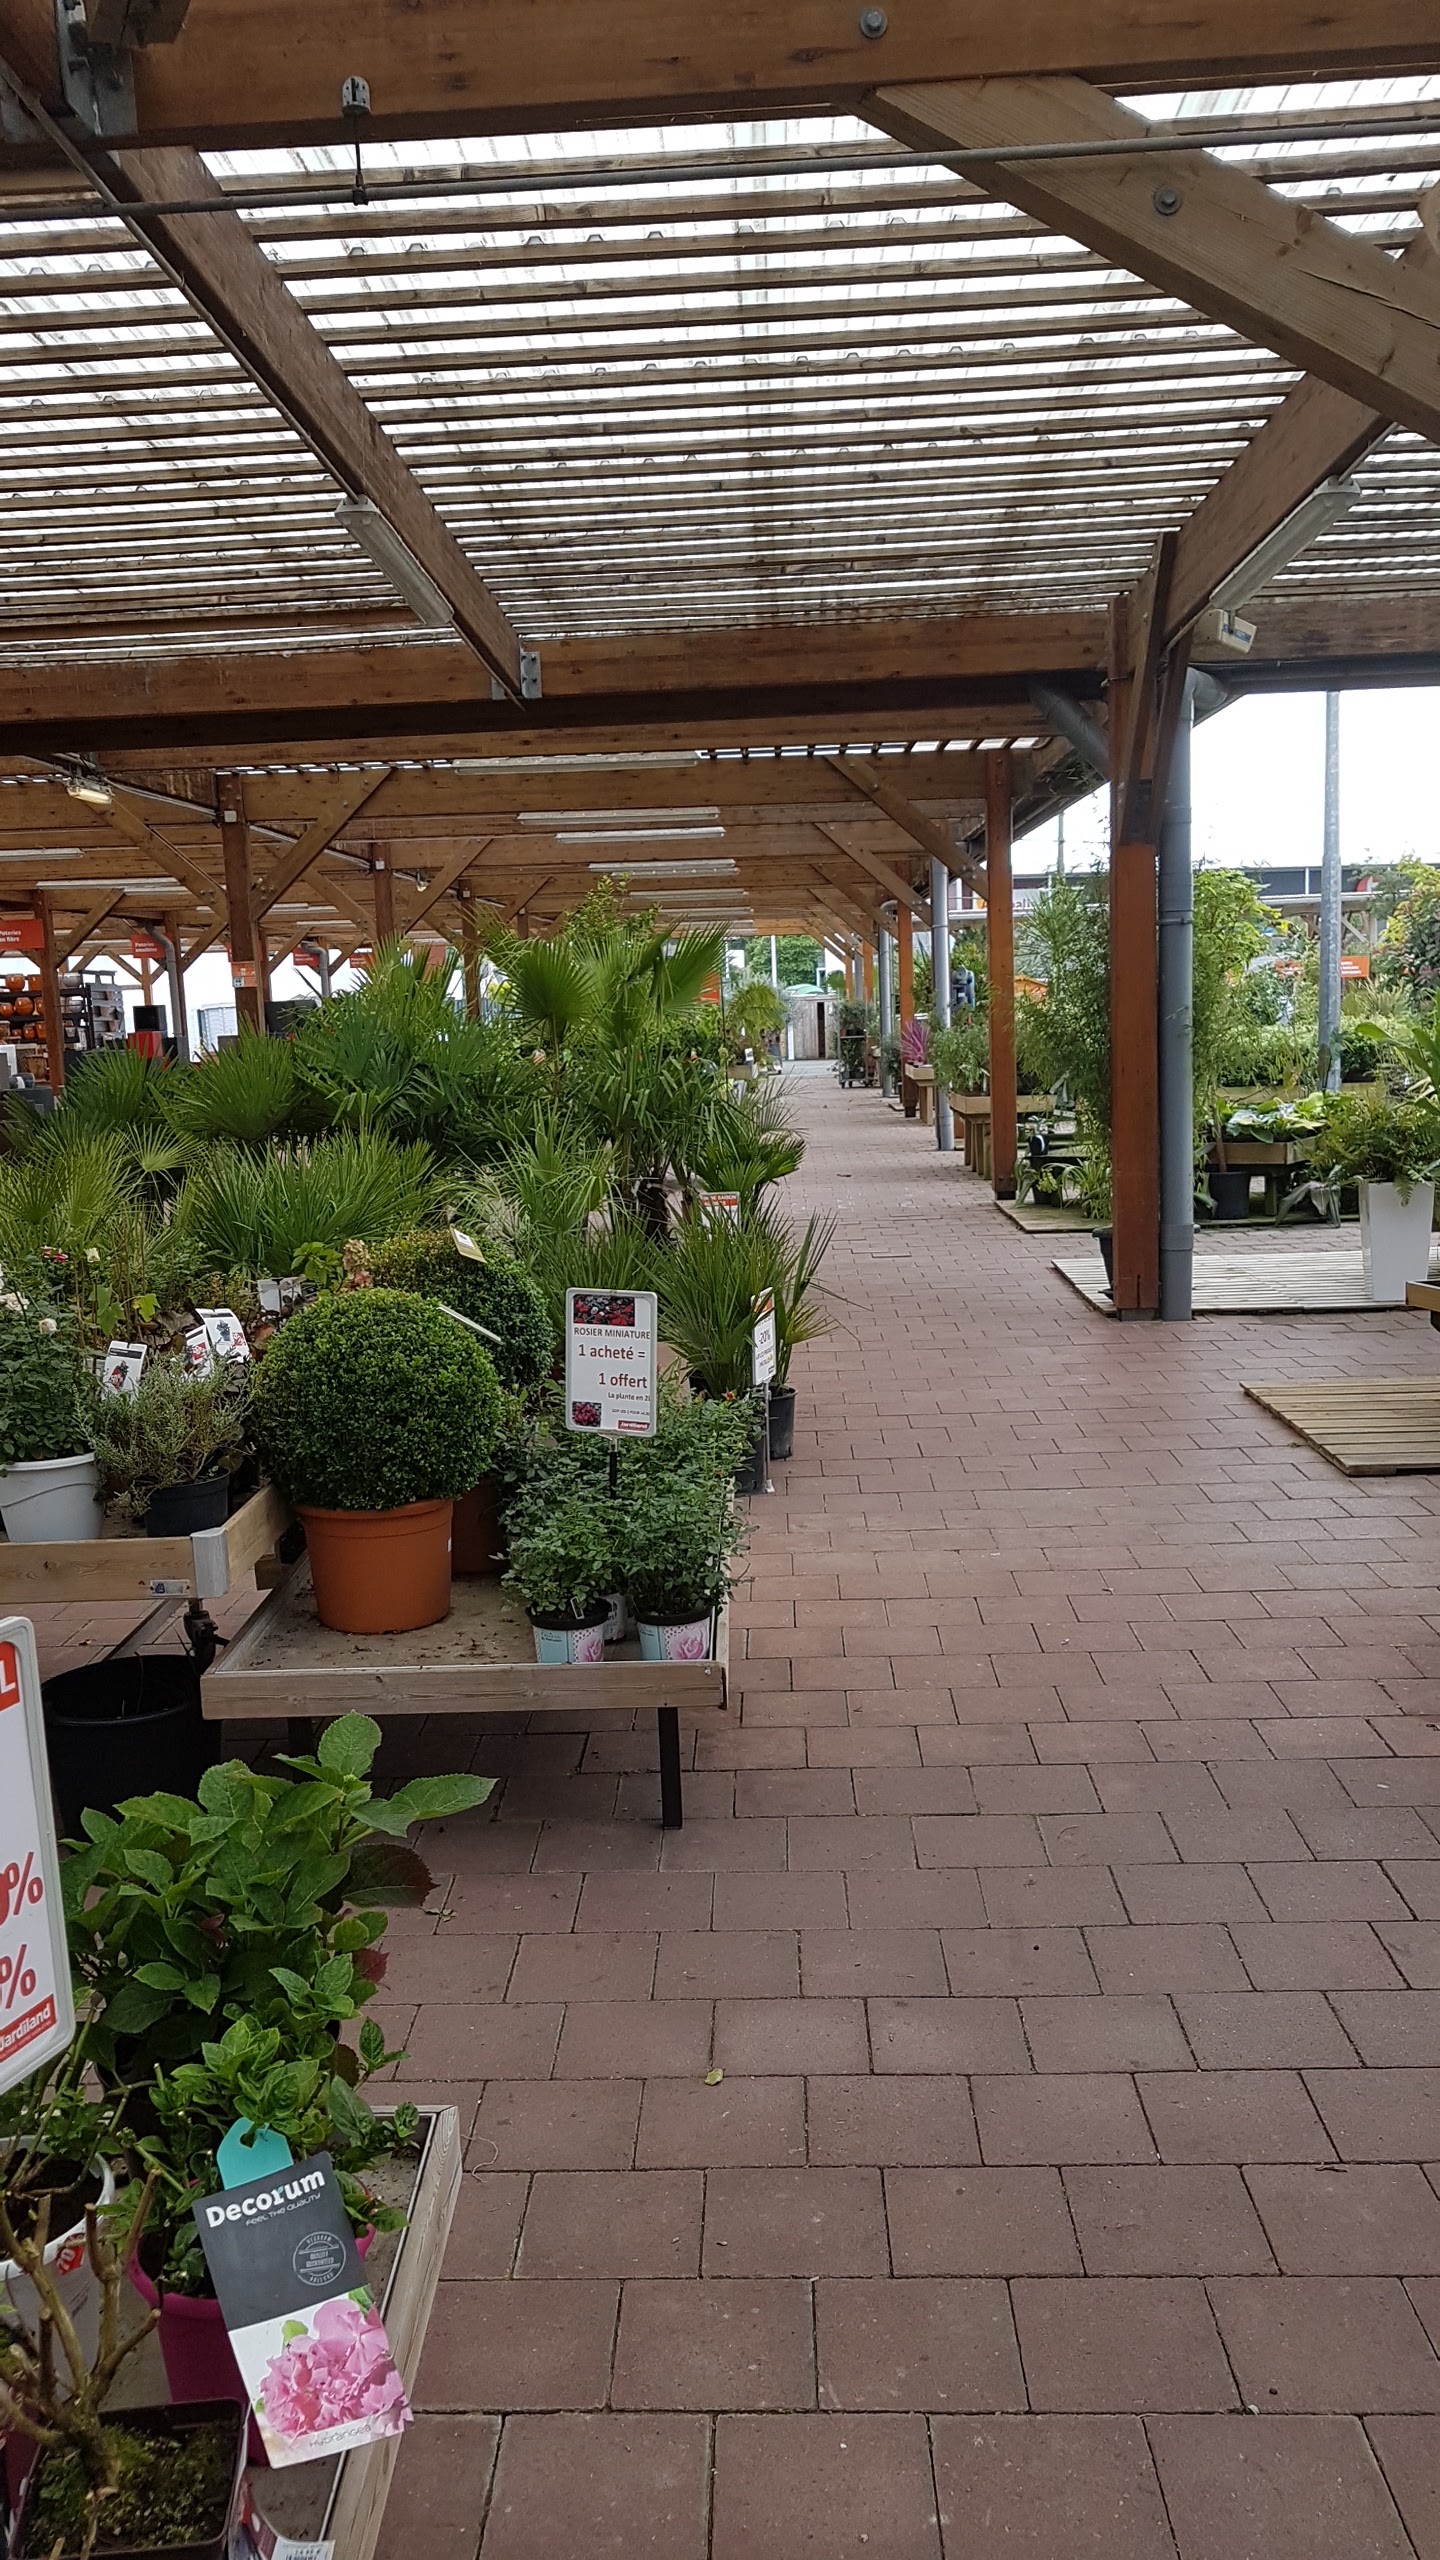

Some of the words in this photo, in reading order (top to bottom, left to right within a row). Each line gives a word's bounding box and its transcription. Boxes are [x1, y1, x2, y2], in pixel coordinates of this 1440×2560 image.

[573, 1327, 603, 1337] ROSIER
[604, 1329, 651, 1340] MINIATURE
[578, 1343, 586, 1357] 1
[589, 1345, 634, 1360] acheté
[598, 1372, 606, 1385] 1
[610, 1373, 648, 1389] offert
[616, 1393, 635, 1401] plante
[205, 2170, 326, 2229] Decorum
[245, 2215, 269, 2227] FEEL
[269, 2207, 286, 2218] THE
